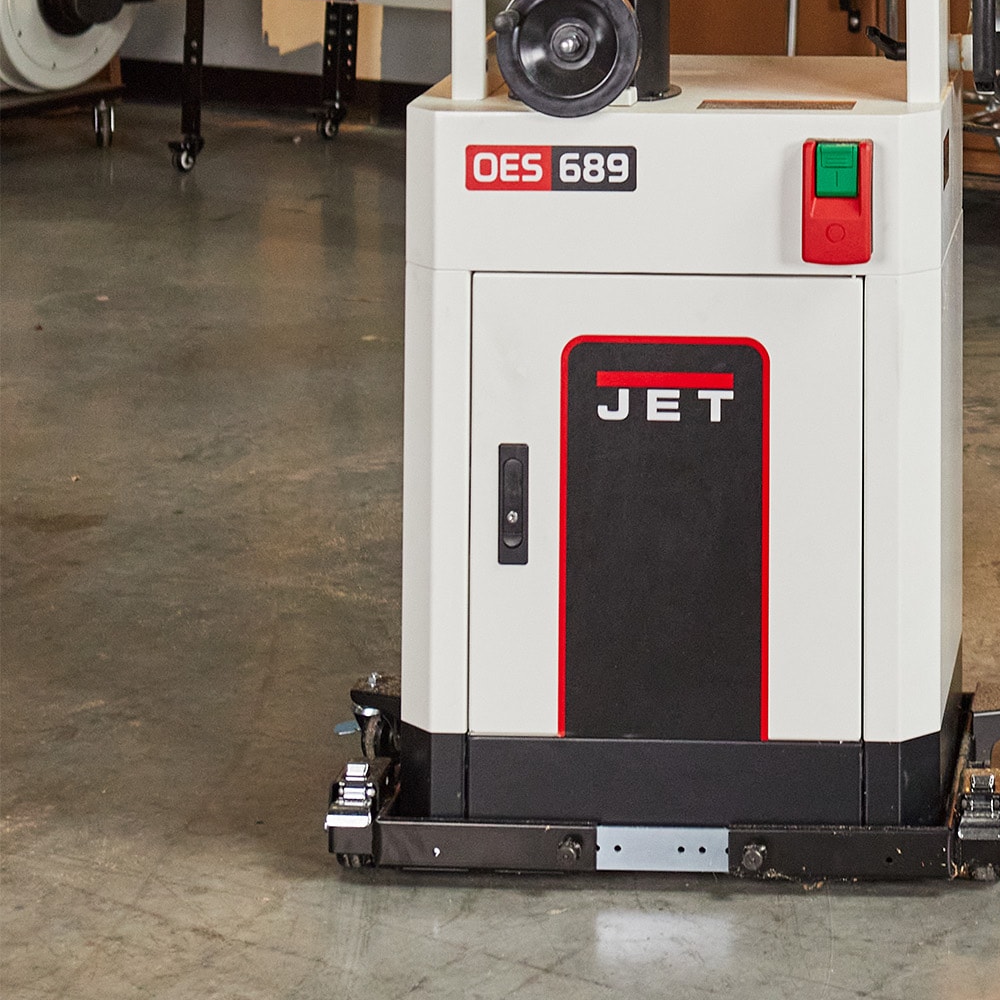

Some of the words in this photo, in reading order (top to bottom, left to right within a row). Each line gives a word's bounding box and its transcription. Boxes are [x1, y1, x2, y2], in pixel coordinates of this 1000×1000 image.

[473, 152, 543, 183] OES
[559, 152, 629, 183] 689
[597, 388, 734, 423] JET
